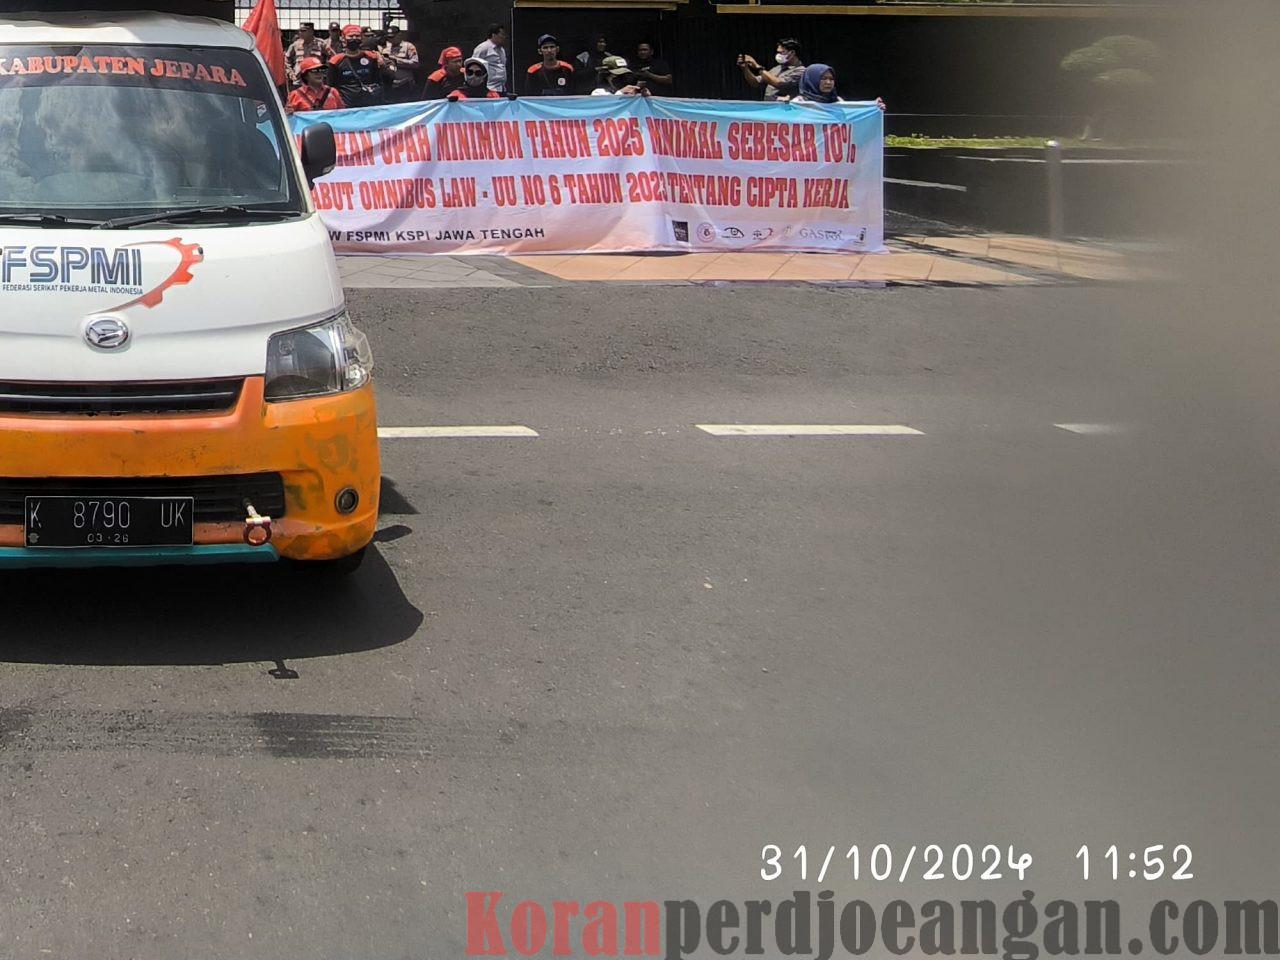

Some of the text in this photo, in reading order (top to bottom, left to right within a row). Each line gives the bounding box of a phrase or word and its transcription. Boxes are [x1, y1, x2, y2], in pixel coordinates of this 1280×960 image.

[150, 58, 247, 87] JEPARA
[379, 125, 431, 165] UPAH
[434, 121, 523, 161] MINIMUM
[525, 119, 592, 159] TAHUN
[594, 117, 645, 157] 2025
[727, 122, 818, 163] SEBESAR
[822, 123, 856, 164] 10%
[311, 182, 354, 210] ABUT
[359, 178, 436, 210] OMNIBUS
[441, 177, 476, 207] LAW
[491, 175, 518, 207] UU
[521, 174, 546, 206] NO
[550, 174, 562, 206] 6
[564, 172, 621, 205] TAHUN
[666, 172, 741, 206] TENTANG
[746, 176, 798, 208] CIPTA
[802, 178, 850, 209] KERJA
[328, 227, 545, 242] W FSPMI KSPI JAWA TENGAH
[2, 246, 142, 286] FSPMI
[33, 284, 58, 292] SERIKAT
[60, 285, 87, 293] PEKERJA
[88, 286, 108, 294] METAL
[110, 286, 144, 295] INDONESIA
[30, 502, 186, 528] K 8790 UK
